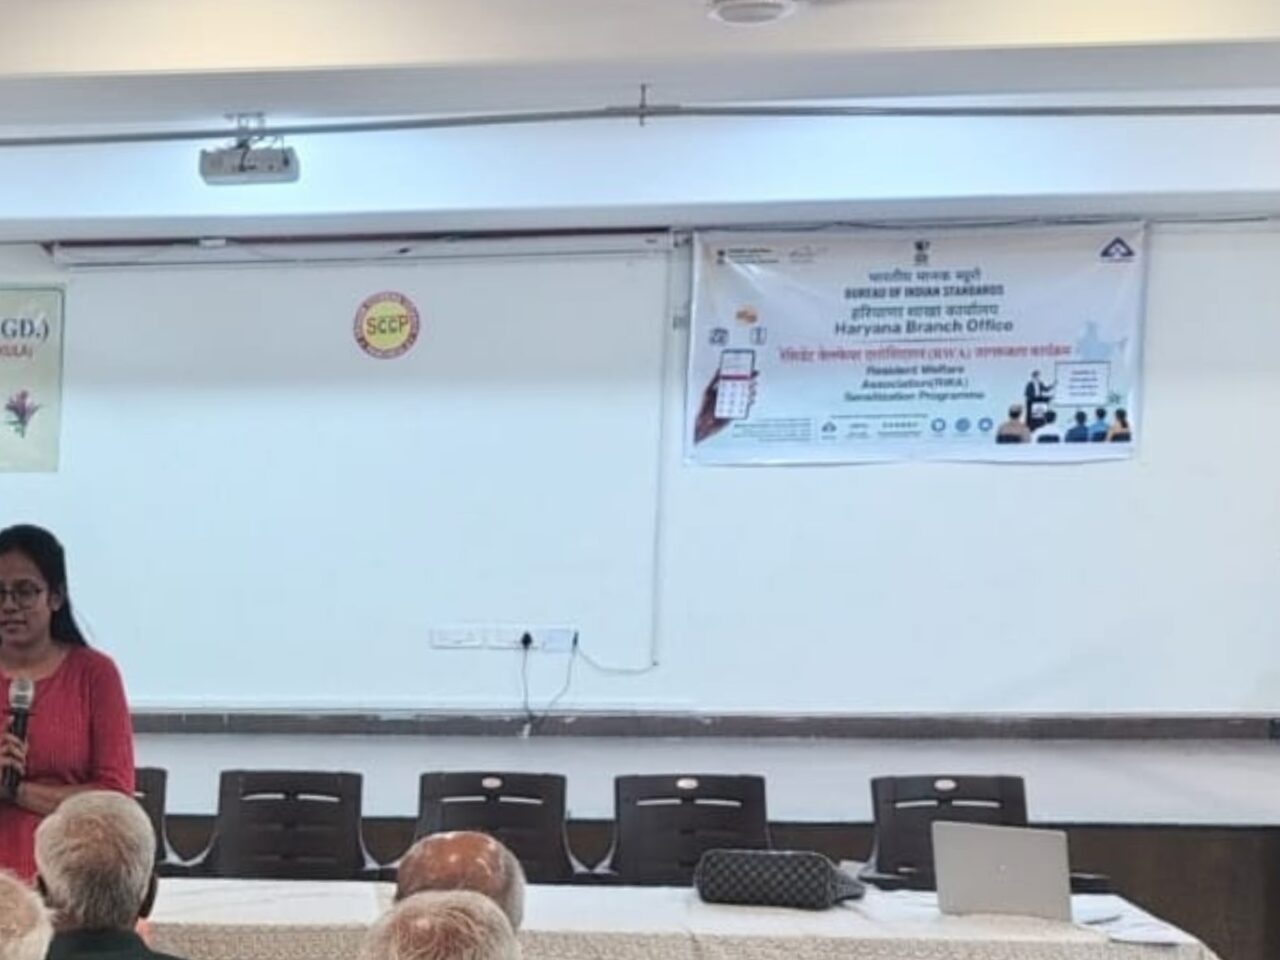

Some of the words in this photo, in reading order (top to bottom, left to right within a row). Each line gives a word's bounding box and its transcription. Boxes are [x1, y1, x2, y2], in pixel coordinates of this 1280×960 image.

[844, 287, 886, 299] BUREAU
[889, 287, 901, 298] OF
[905, 286, 940, 298] INDIAN
[943, 285, 1004, 297] STANDARDS
[366, 315, 409, 336] SCCP
[835, 321, 901, 337] Haryana
[906, 320, 963, 334] Branch
[966, 318, 1014, 333] Office
[867, 365, 917, 376] Resident
[922, 364, 964, 375] Welfare
